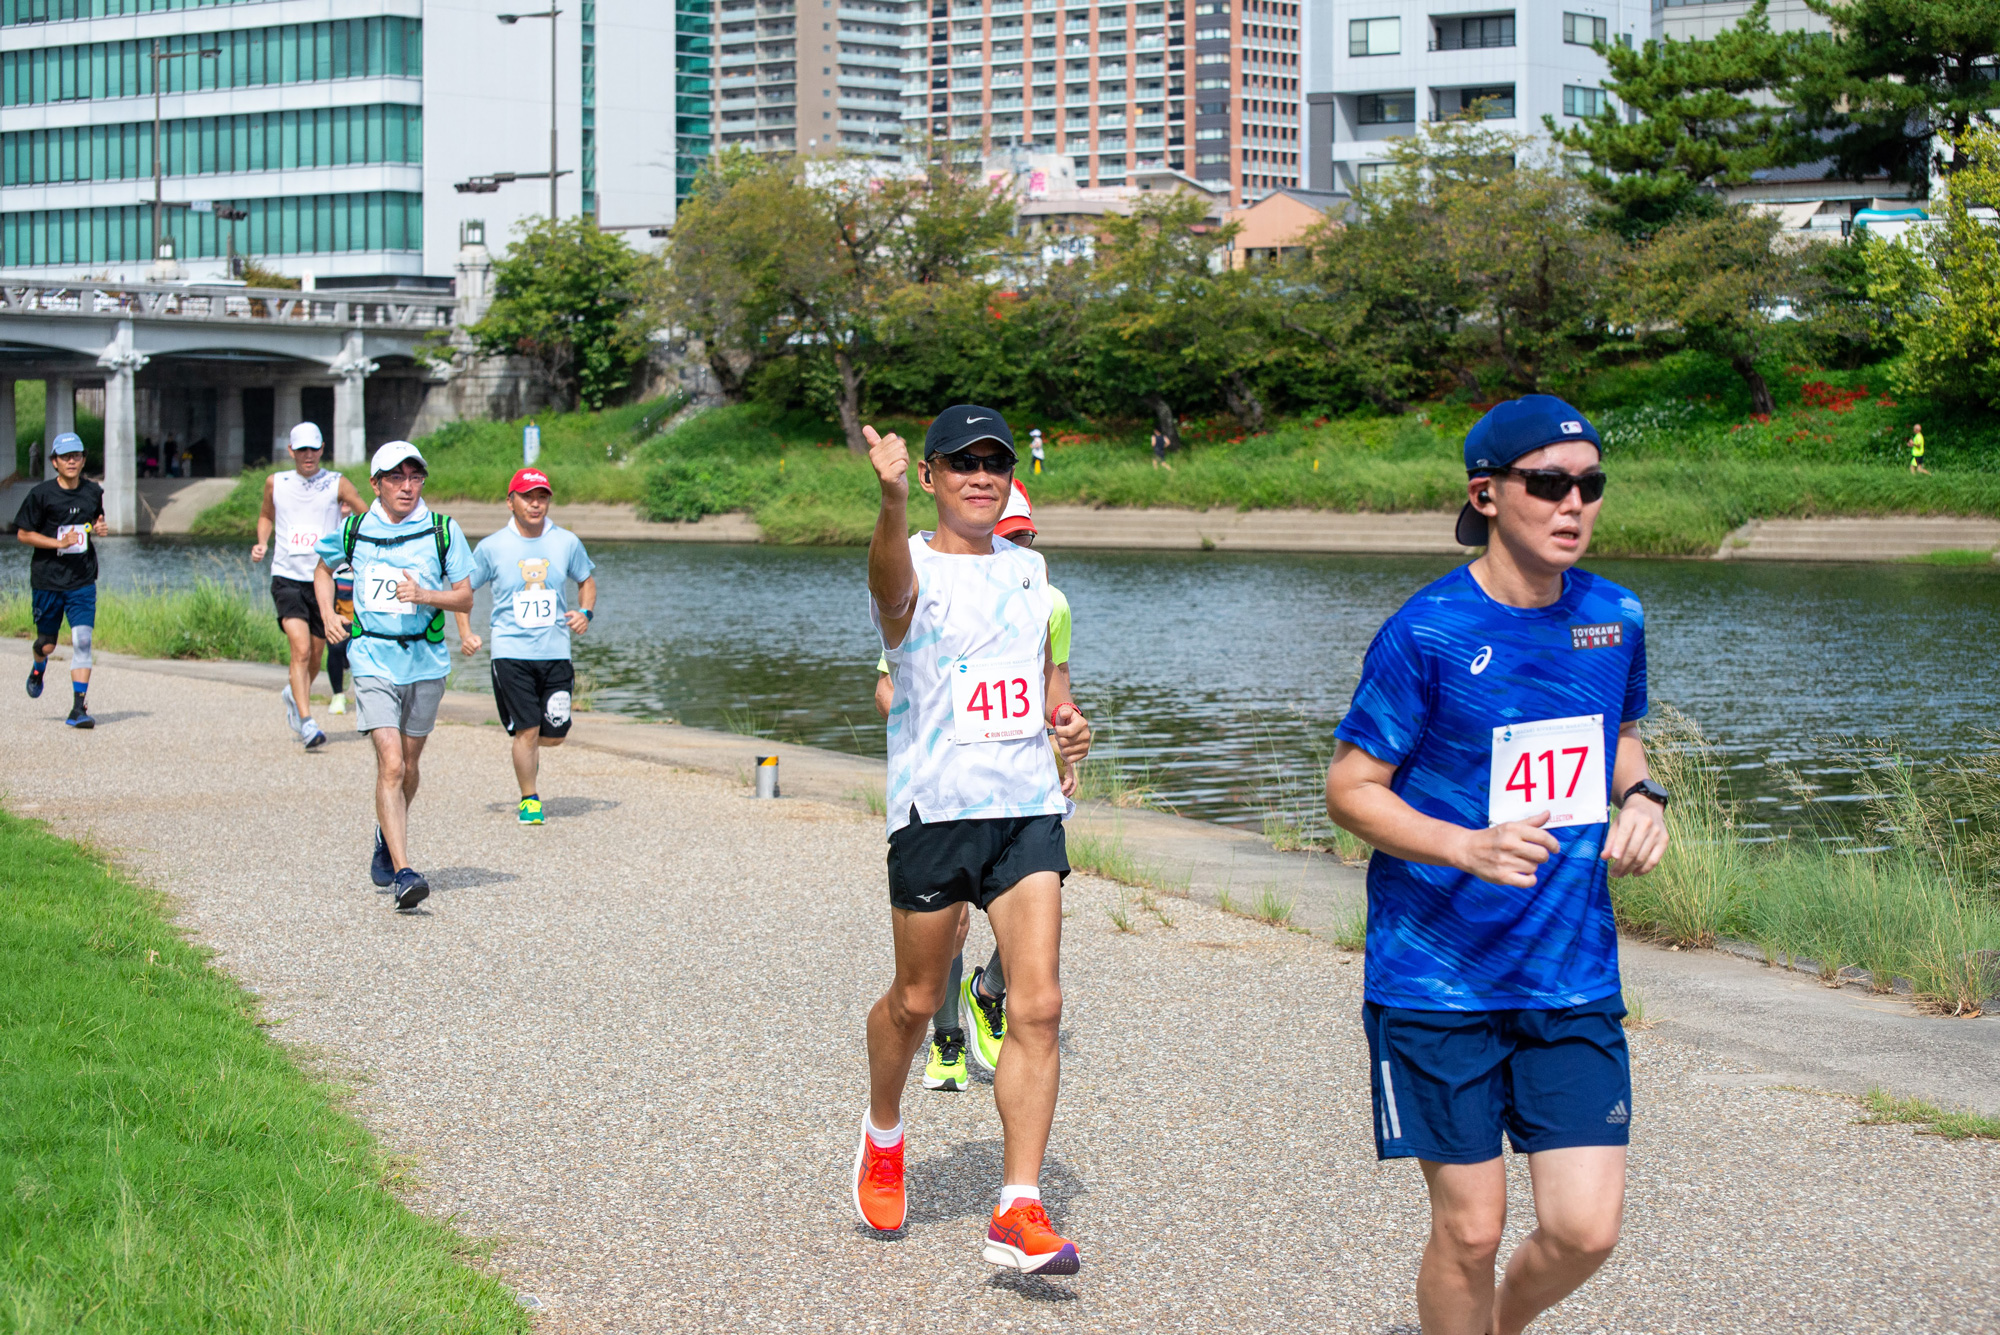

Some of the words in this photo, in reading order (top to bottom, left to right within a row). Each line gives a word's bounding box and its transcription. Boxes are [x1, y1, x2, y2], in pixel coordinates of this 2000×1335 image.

[291, 533, 319, 547] 462
[372, 578, 399, 601] 79
[520, 600, 551, 618] 713
[1572, 625, 1620, 637] TOYOKAWA
[967, 678, 1030, 720] 413
[1505, 746, 1588, 802] 417
